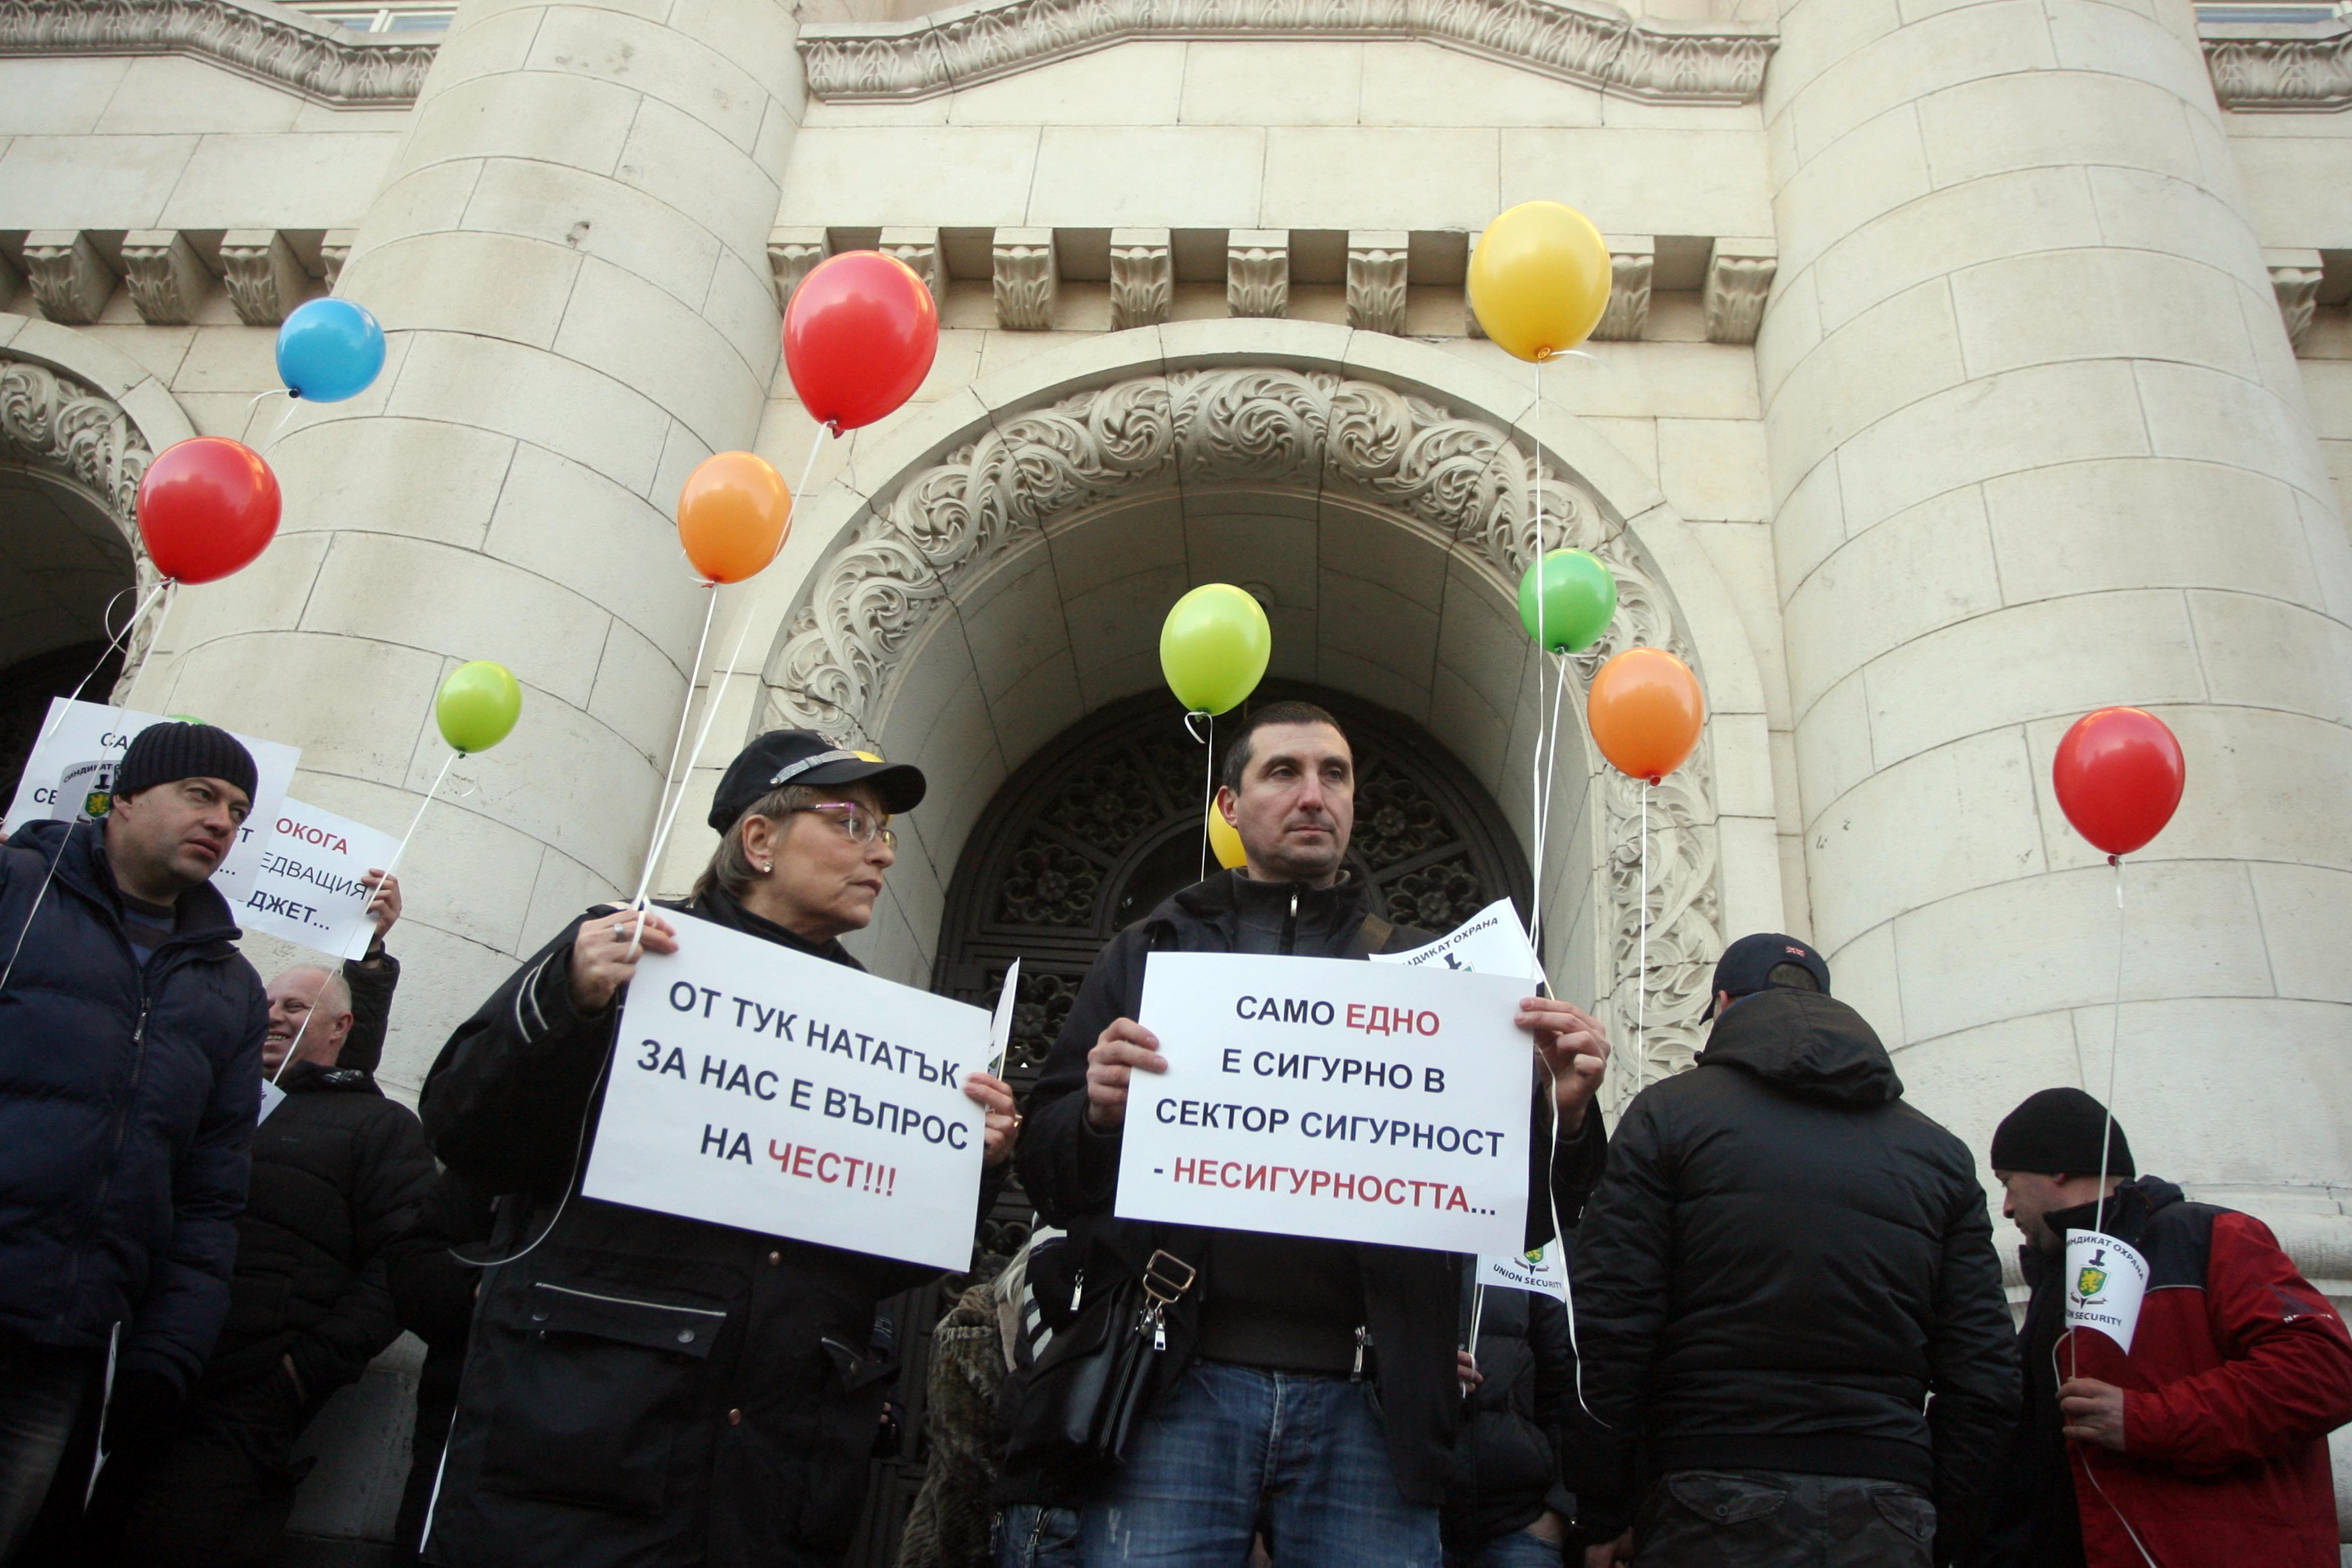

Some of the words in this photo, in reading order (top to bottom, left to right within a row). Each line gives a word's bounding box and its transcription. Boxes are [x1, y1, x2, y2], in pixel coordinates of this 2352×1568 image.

[237, 890, 330, 930] ДЖЕТ...
[1453, 917, 1498, 943] ОХРАНА
[669, 981, 721, 1018] ОТ
[732, 997, 798, 1042] ТУК
[807, 1019, 960, 1090] НАТАТЪК
[1236, 996, 1335, 1026] САМО
[1346, 1004, 1440, 1036] ЕДНО
[1222, 1048, 1242, 1074] Е
[1253, 1051, 1413, 1090] СИГУРНО
[1424, 1067, 1445, 1094] В
[637, 1039, 687, 1080] ЗА
[700, 1055, 779, 1101] НАС
[790, 1078, 814, 1112] Е
[823, 1087, 968, 1150] ВЪПРОС
[1156, 1098, 1290, 1133] СЕКТОР
[1300, 1112, 1505, 1158] СИГУРНОСТ
[701, 1123, 753, 1165] НА
[769, 1139, 896, 1196] ЧЕСТ!!!
[1174, 1157, 1496, 1216] НЕСИГУРНОСТТА...
[1493, 1263, 1523, 1283] UNION
[2113, 1244, 2145, 1281] ОХРАНА
[2075, 1311, 2122, 1327] SECURITY
